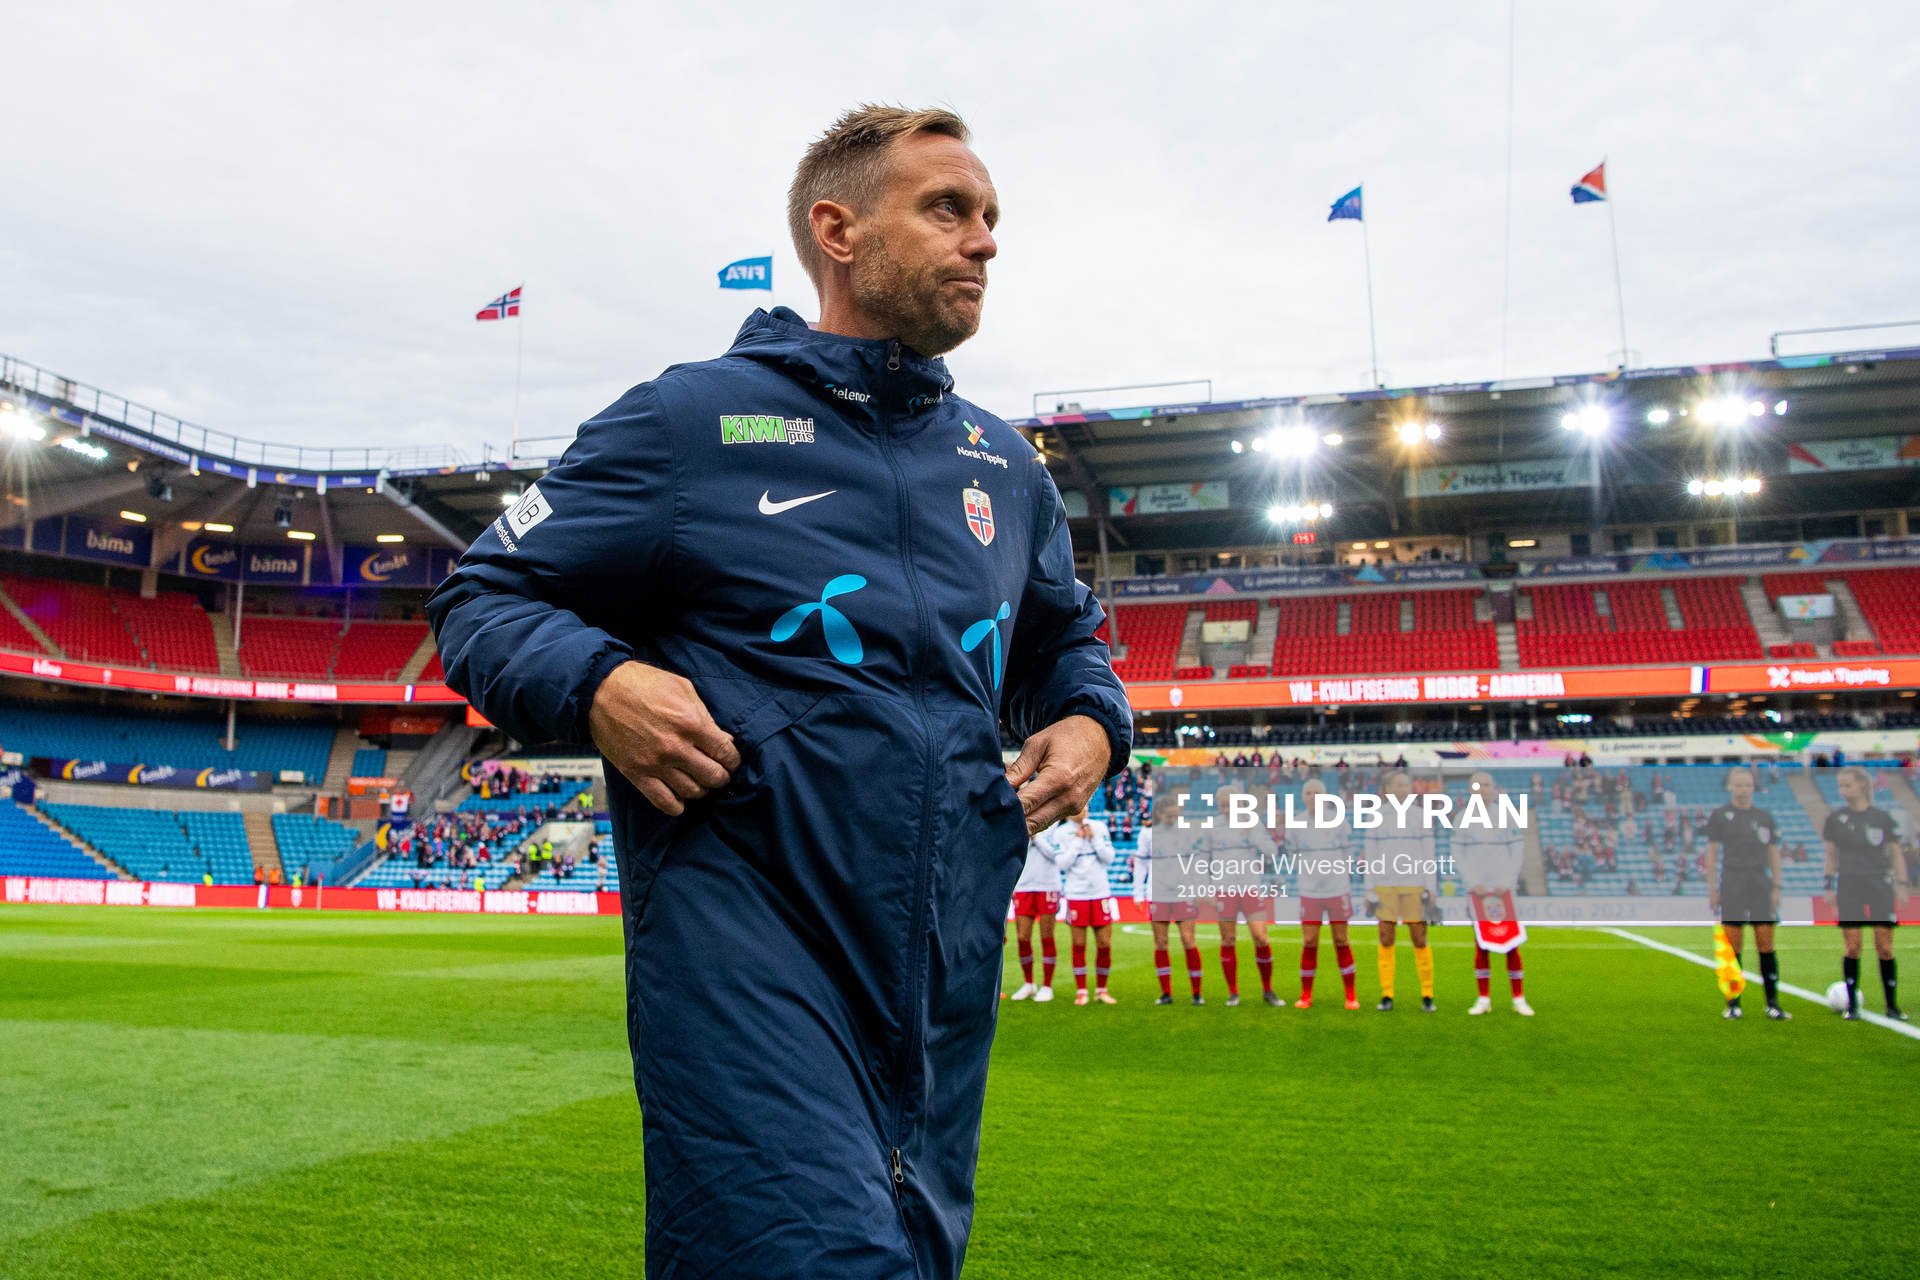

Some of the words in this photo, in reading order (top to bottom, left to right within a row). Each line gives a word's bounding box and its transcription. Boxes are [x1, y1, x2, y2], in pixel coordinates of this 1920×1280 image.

[832, 387, 871, 404] telenor
[721, 415, 787, 444] KIWI
[786, 418, 814, 432] mini
[787, 431, 814, 444] pris
[956, 445, 982, 460] Norsk
[980, 451, 1008, 468] Tipping
[1545, 903, 1583, 922] Cup
